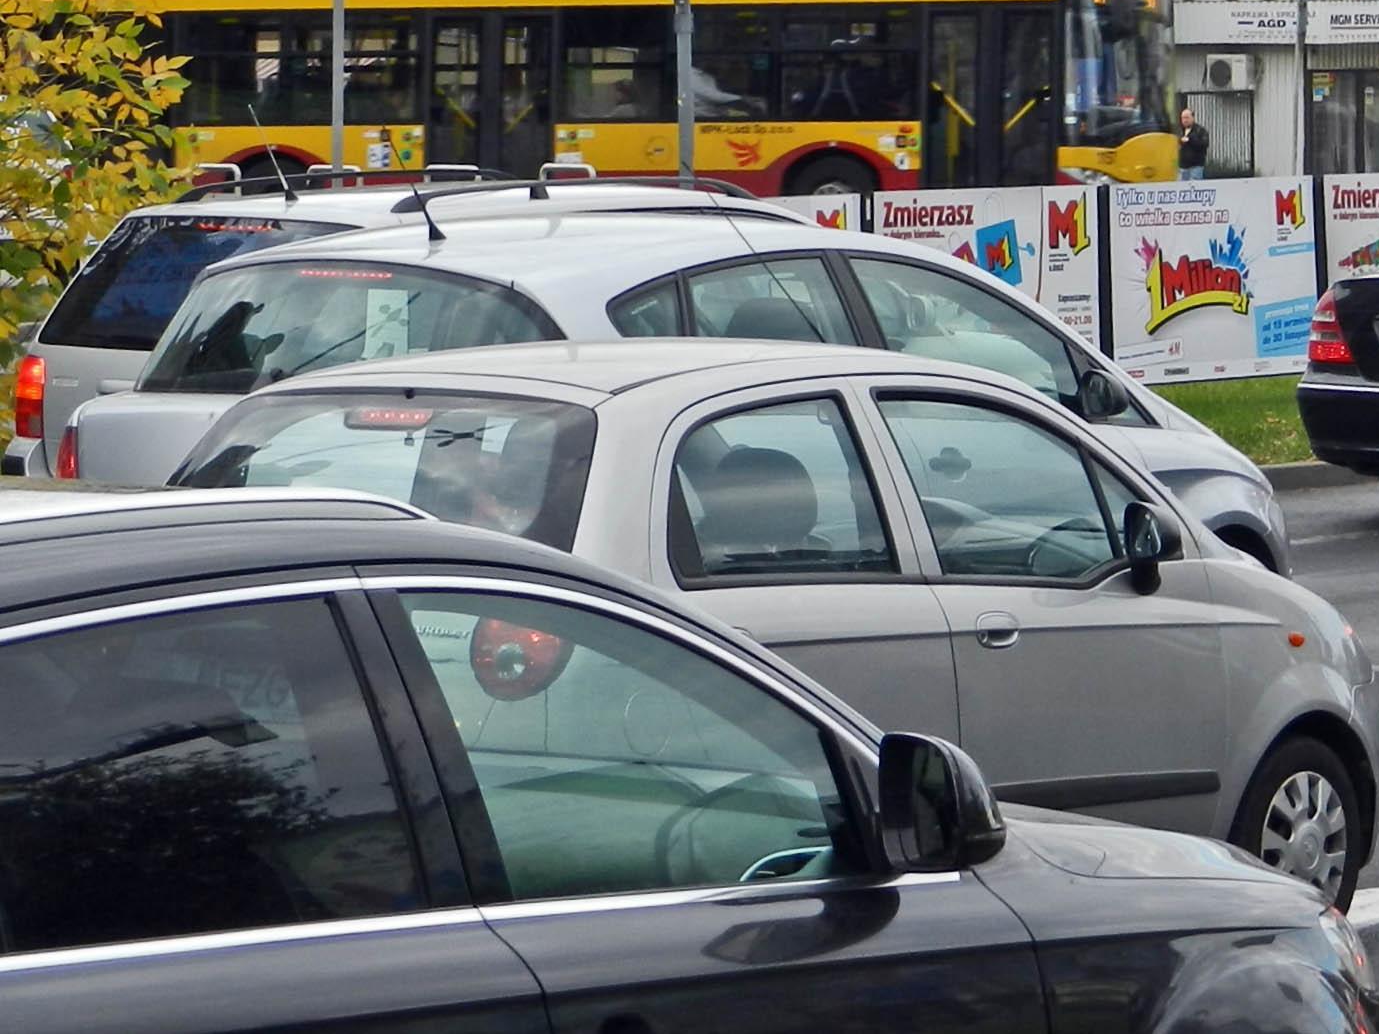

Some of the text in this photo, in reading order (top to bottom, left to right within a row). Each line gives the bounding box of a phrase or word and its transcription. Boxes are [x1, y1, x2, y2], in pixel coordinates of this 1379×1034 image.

[1257, 19, 1287, 28] AGD
[1330, 14, 1352, 25] MGM
[1116, 186, 1217, 209] Tylko u nas zakupy
[1275, 183, 1306, 230] M1
[883, 198, 974, 228] Zmierzasz
[1048, 191, 1091, 256] M1
[1119, 208, 1229, 226] to wielka szansa na
[985, 231, 1014, 271] M1
[1161, 255, 1242, 307] Milion
